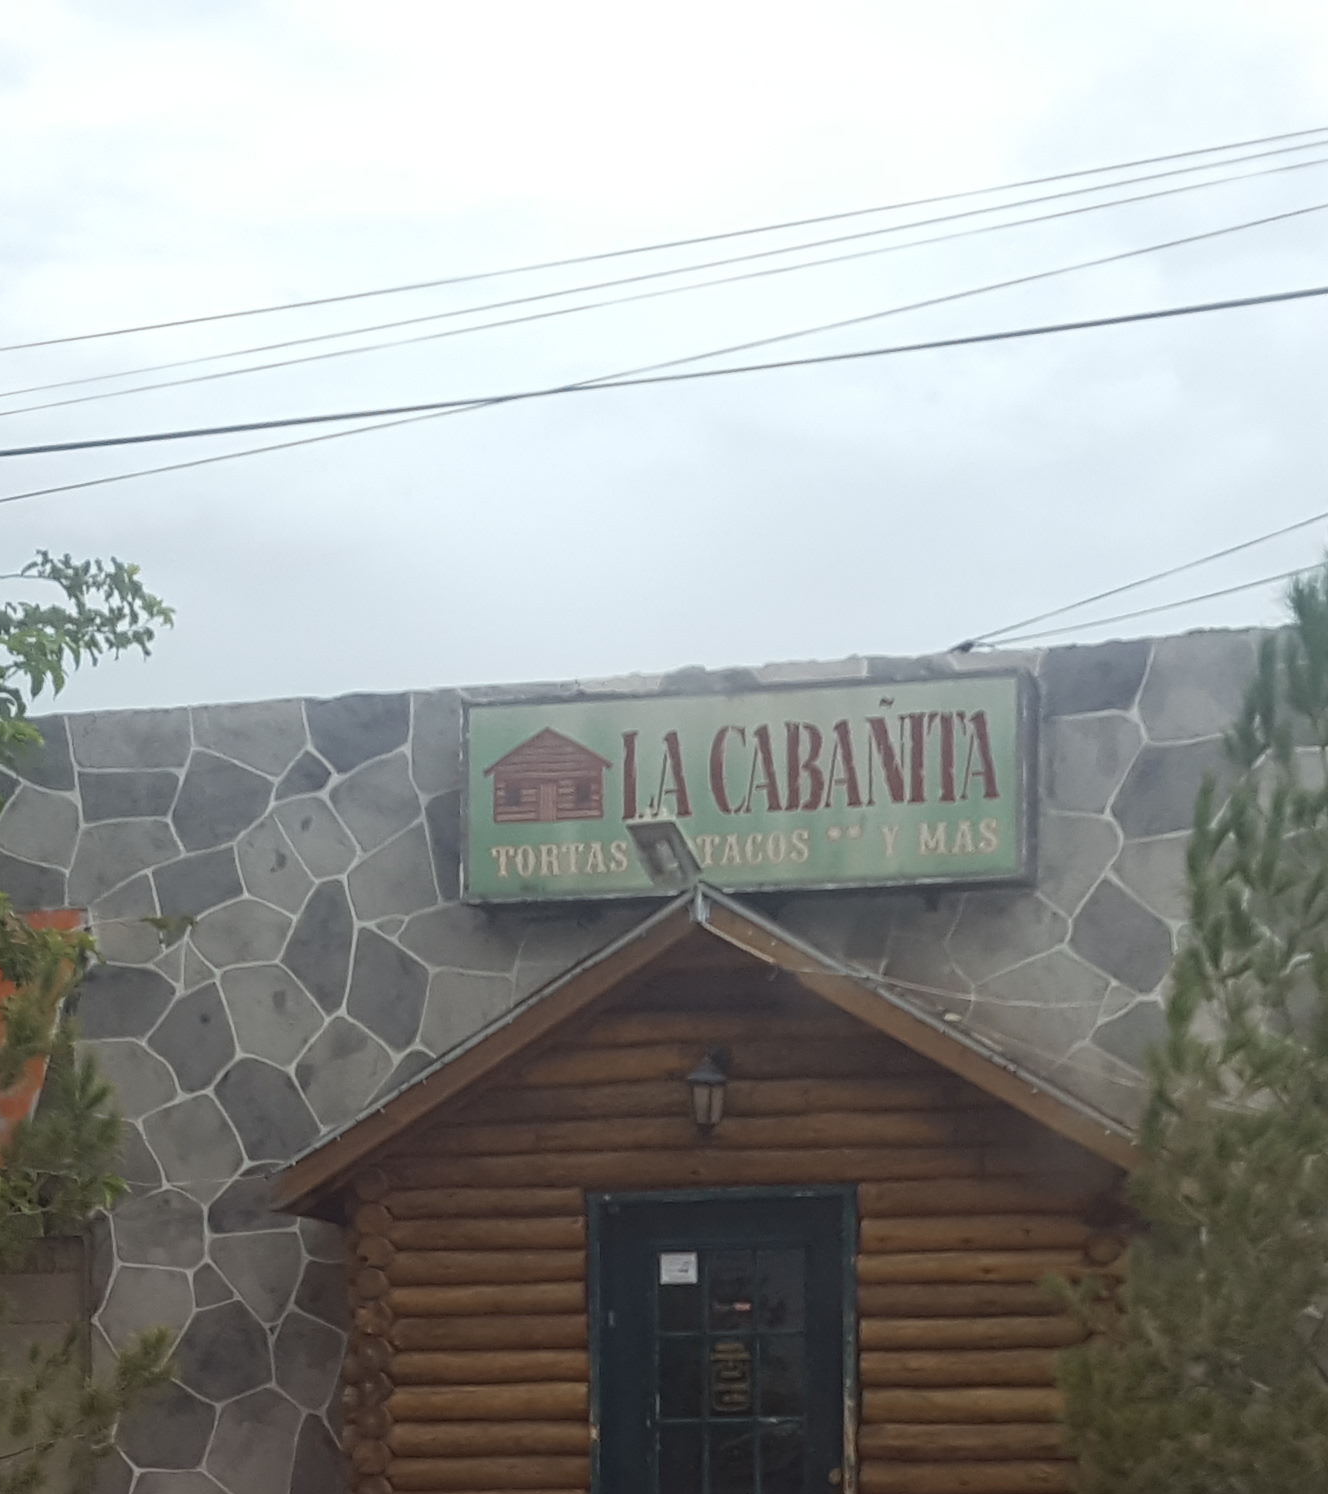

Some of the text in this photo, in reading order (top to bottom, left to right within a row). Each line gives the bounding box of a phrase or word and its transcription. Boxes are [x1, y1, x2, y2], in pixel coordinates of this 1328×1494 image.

[621, 697, 1001, 821] LA CABAÑITA
[490, 818, 1000, 878] TORTAS TACOS Y MAS
